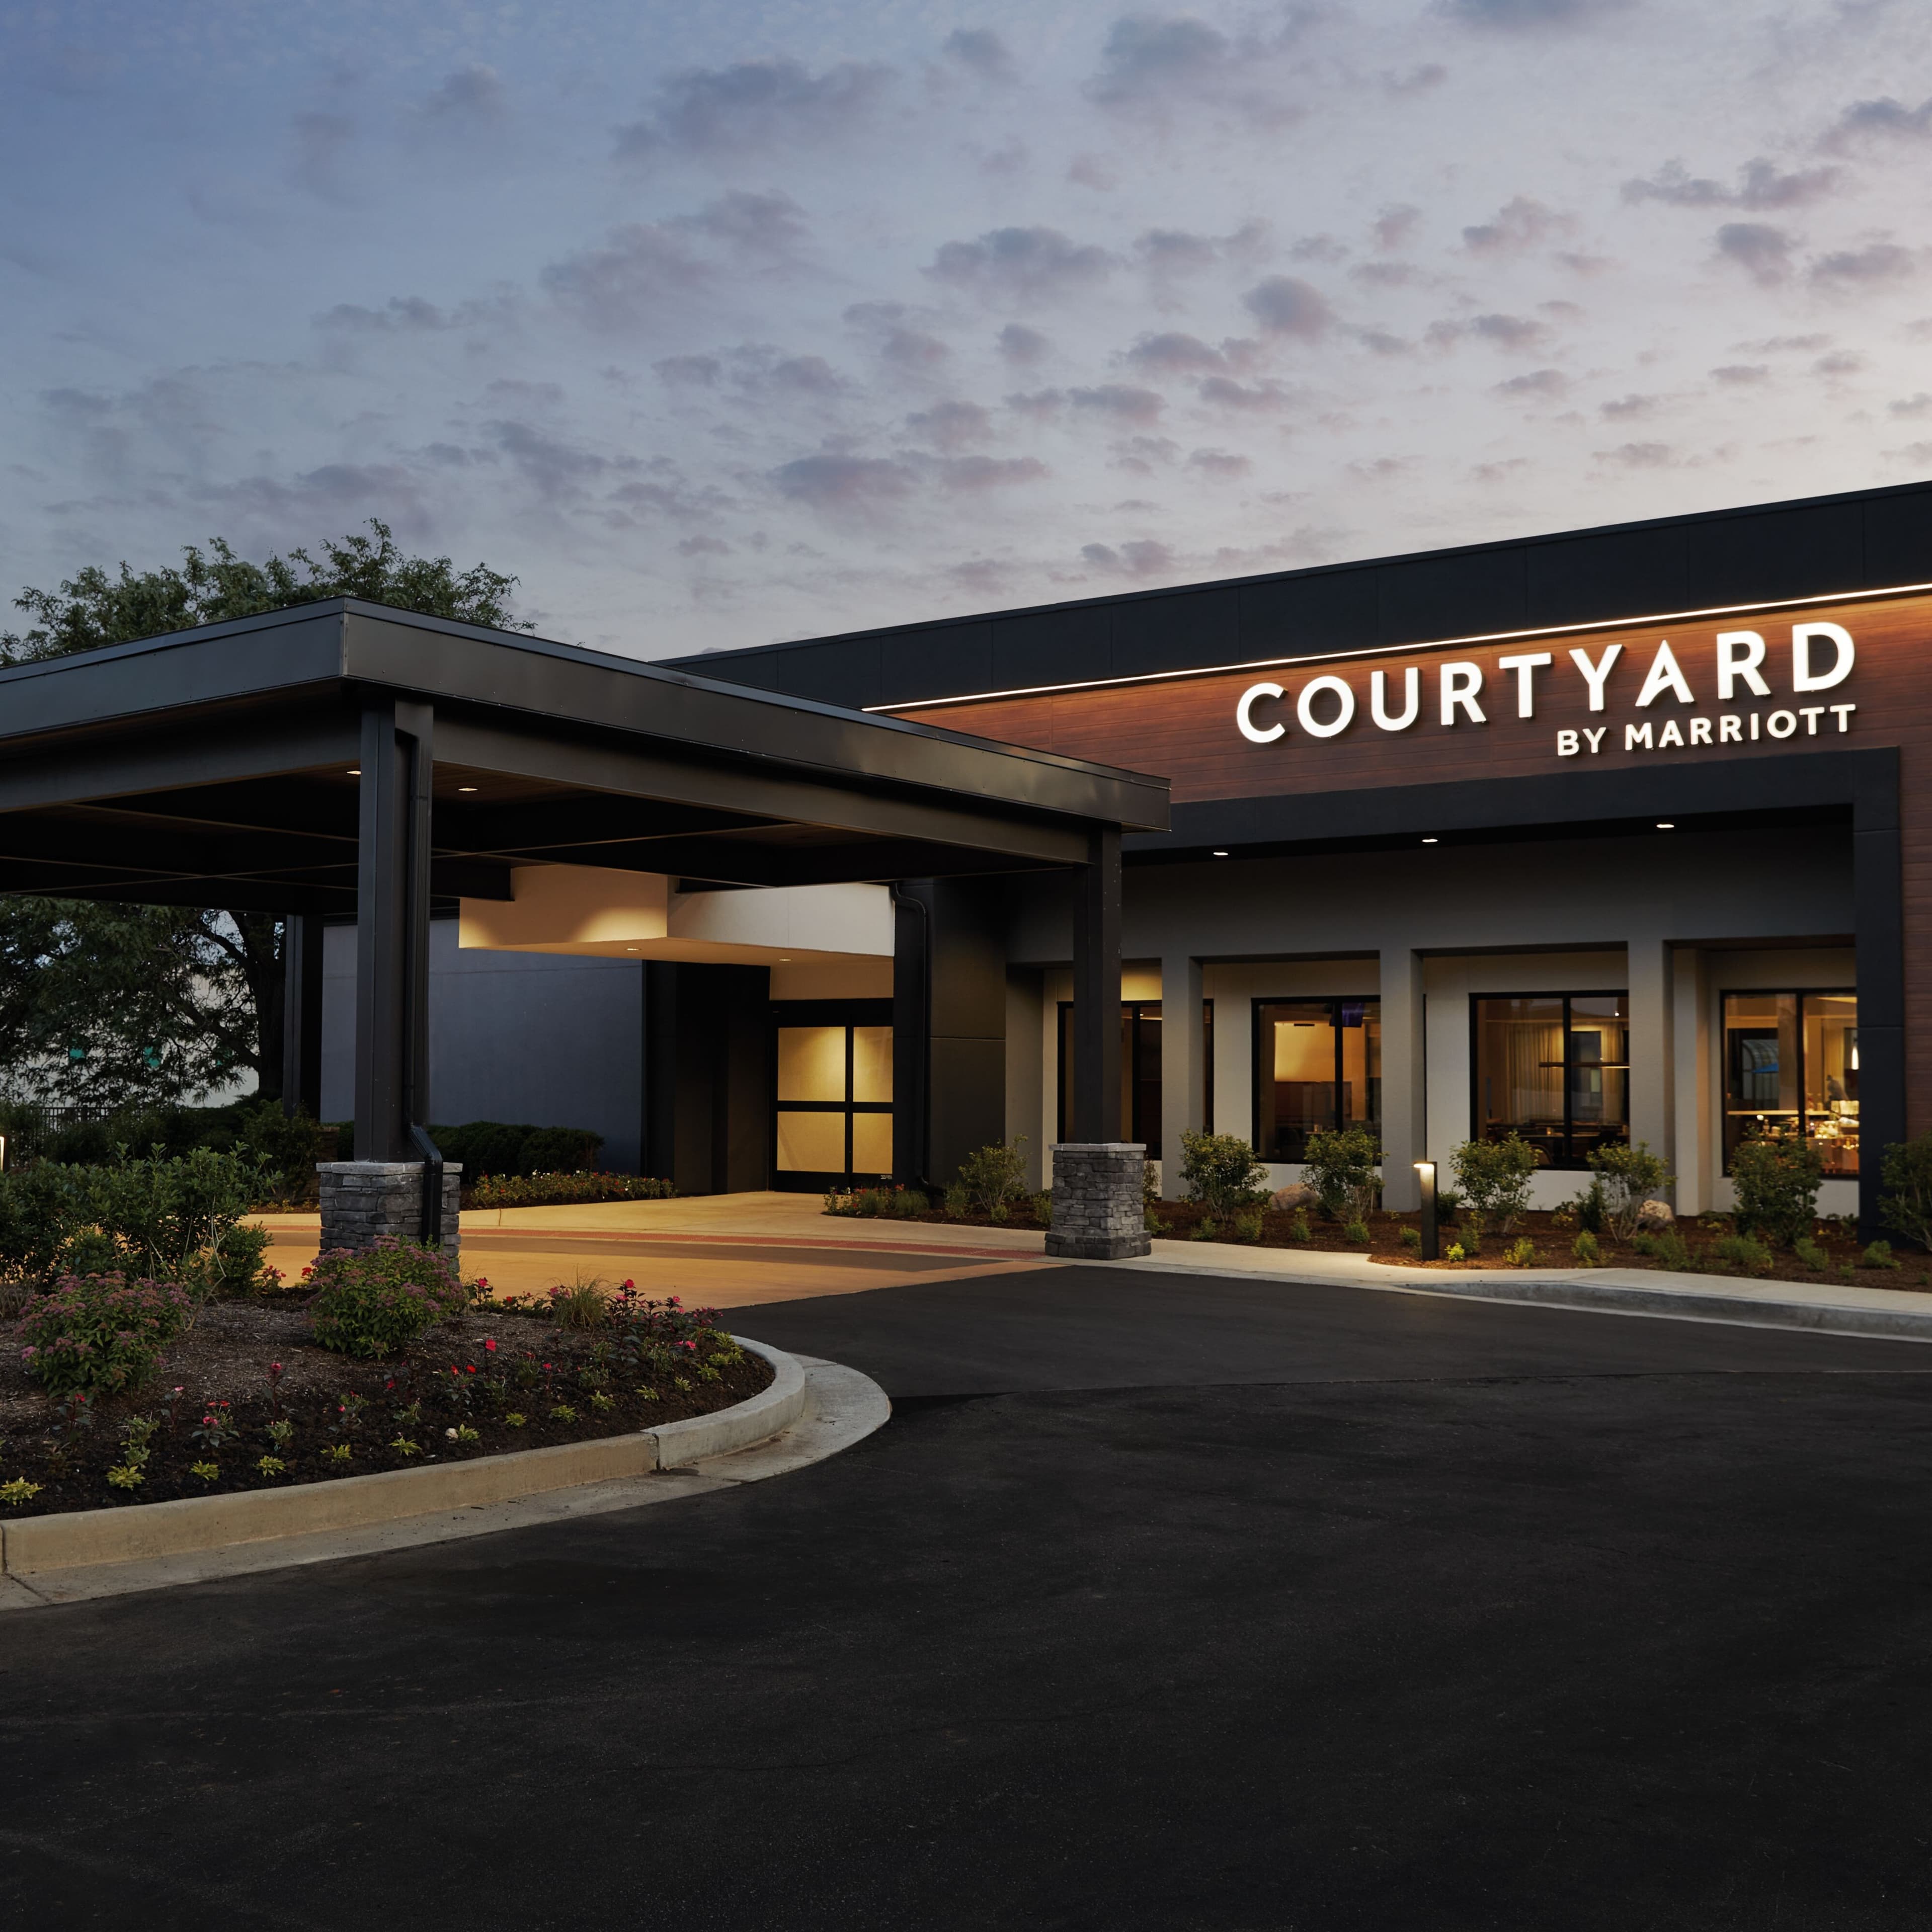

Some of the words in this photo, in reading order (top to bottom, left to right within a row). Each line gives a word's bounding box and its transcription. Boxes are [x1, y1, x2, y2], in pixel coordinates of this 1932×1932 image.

[1236, 622, 1855, 743] COURTYARD
[1557, 727, 1606, 756] BY
[1625, 704, 1856, 751] MARRIOTT
